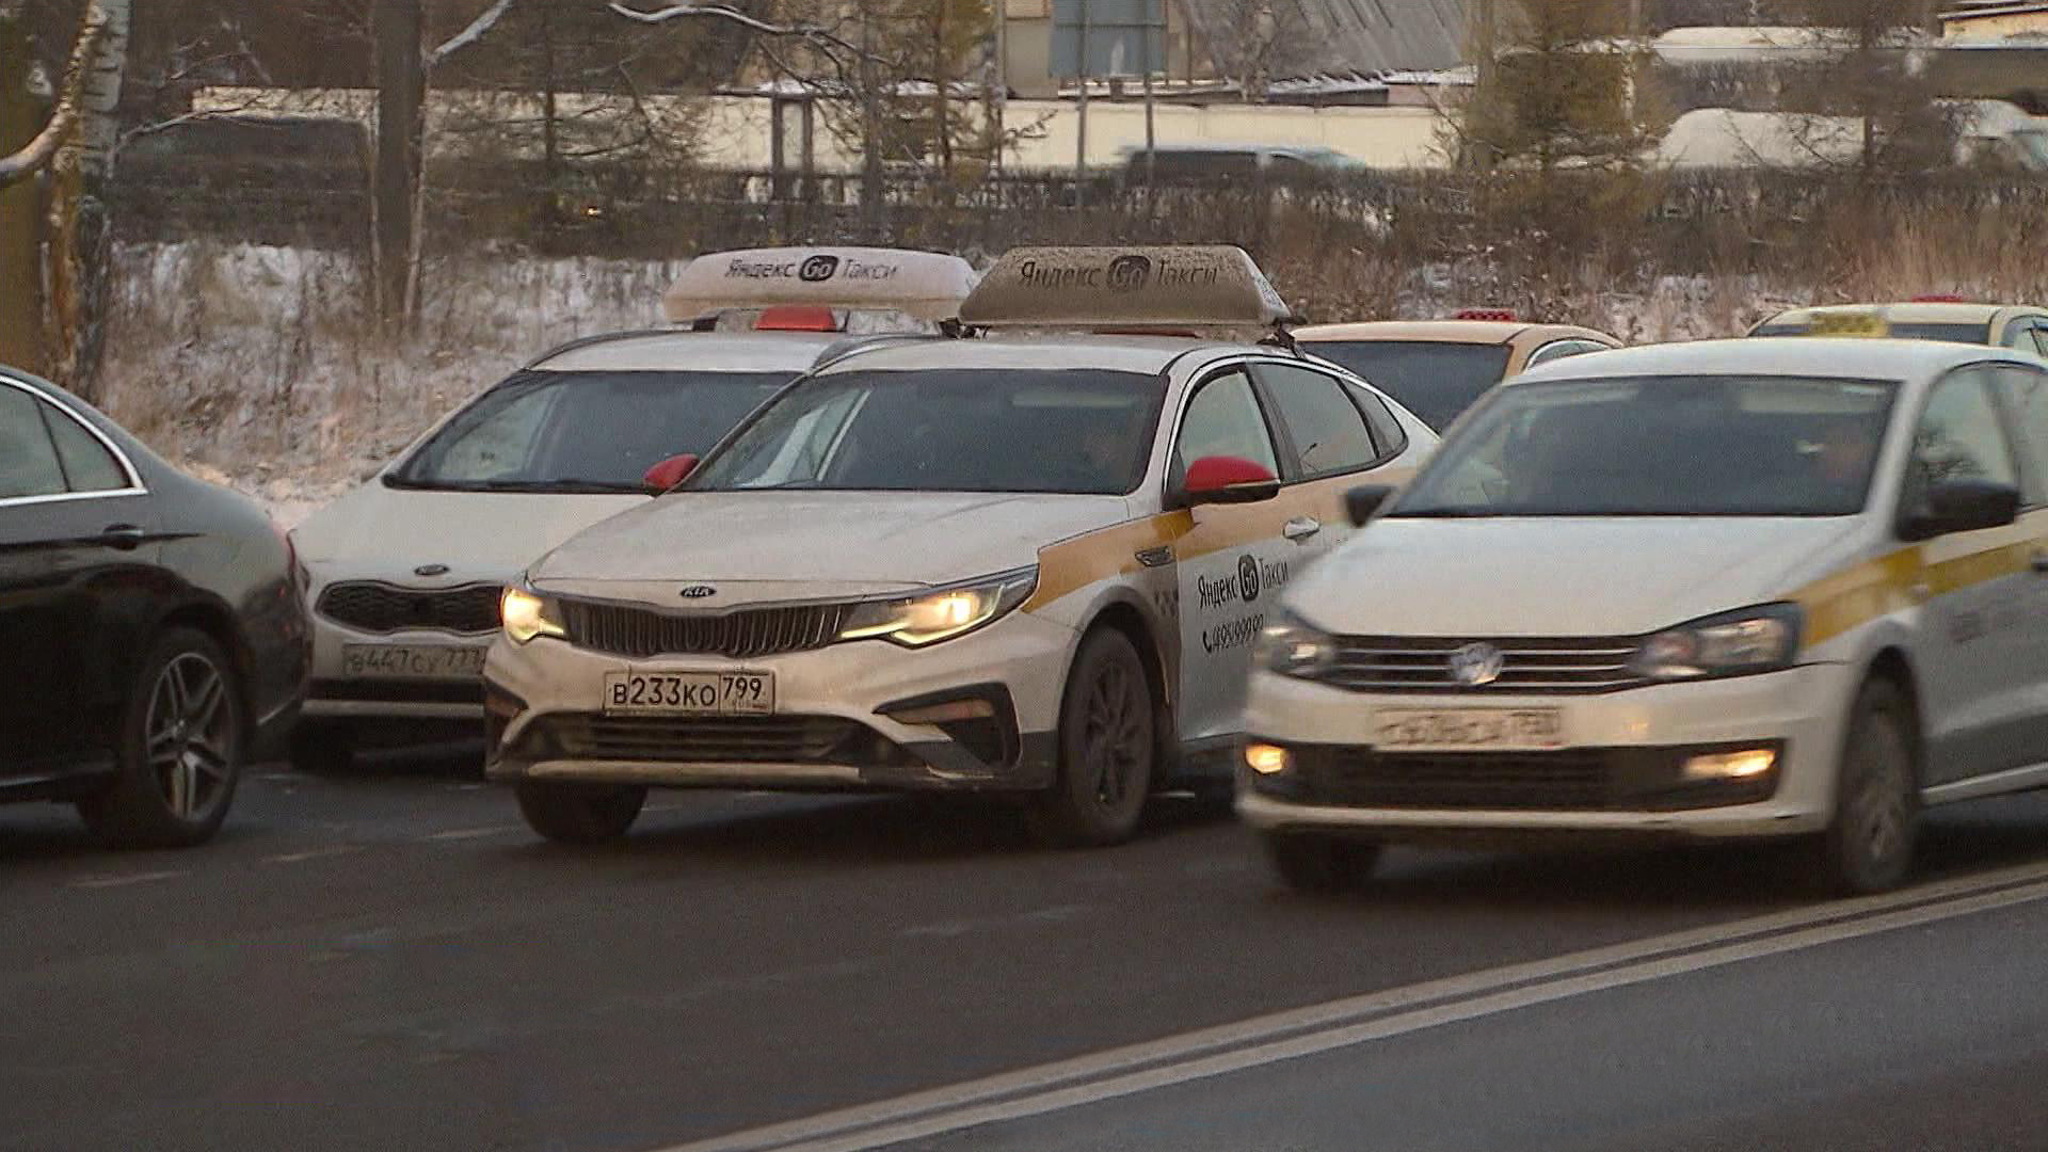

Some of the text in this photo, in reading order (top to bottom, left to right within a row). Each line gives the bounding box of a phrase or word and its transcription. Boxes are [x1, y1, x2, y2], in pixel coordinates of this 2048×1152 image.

[725, 256, 897, 280] Яндекс Go Такси
[1198, 575, 1238, 609] Яндекс
[1259, 558, 1289, 590] Такси
